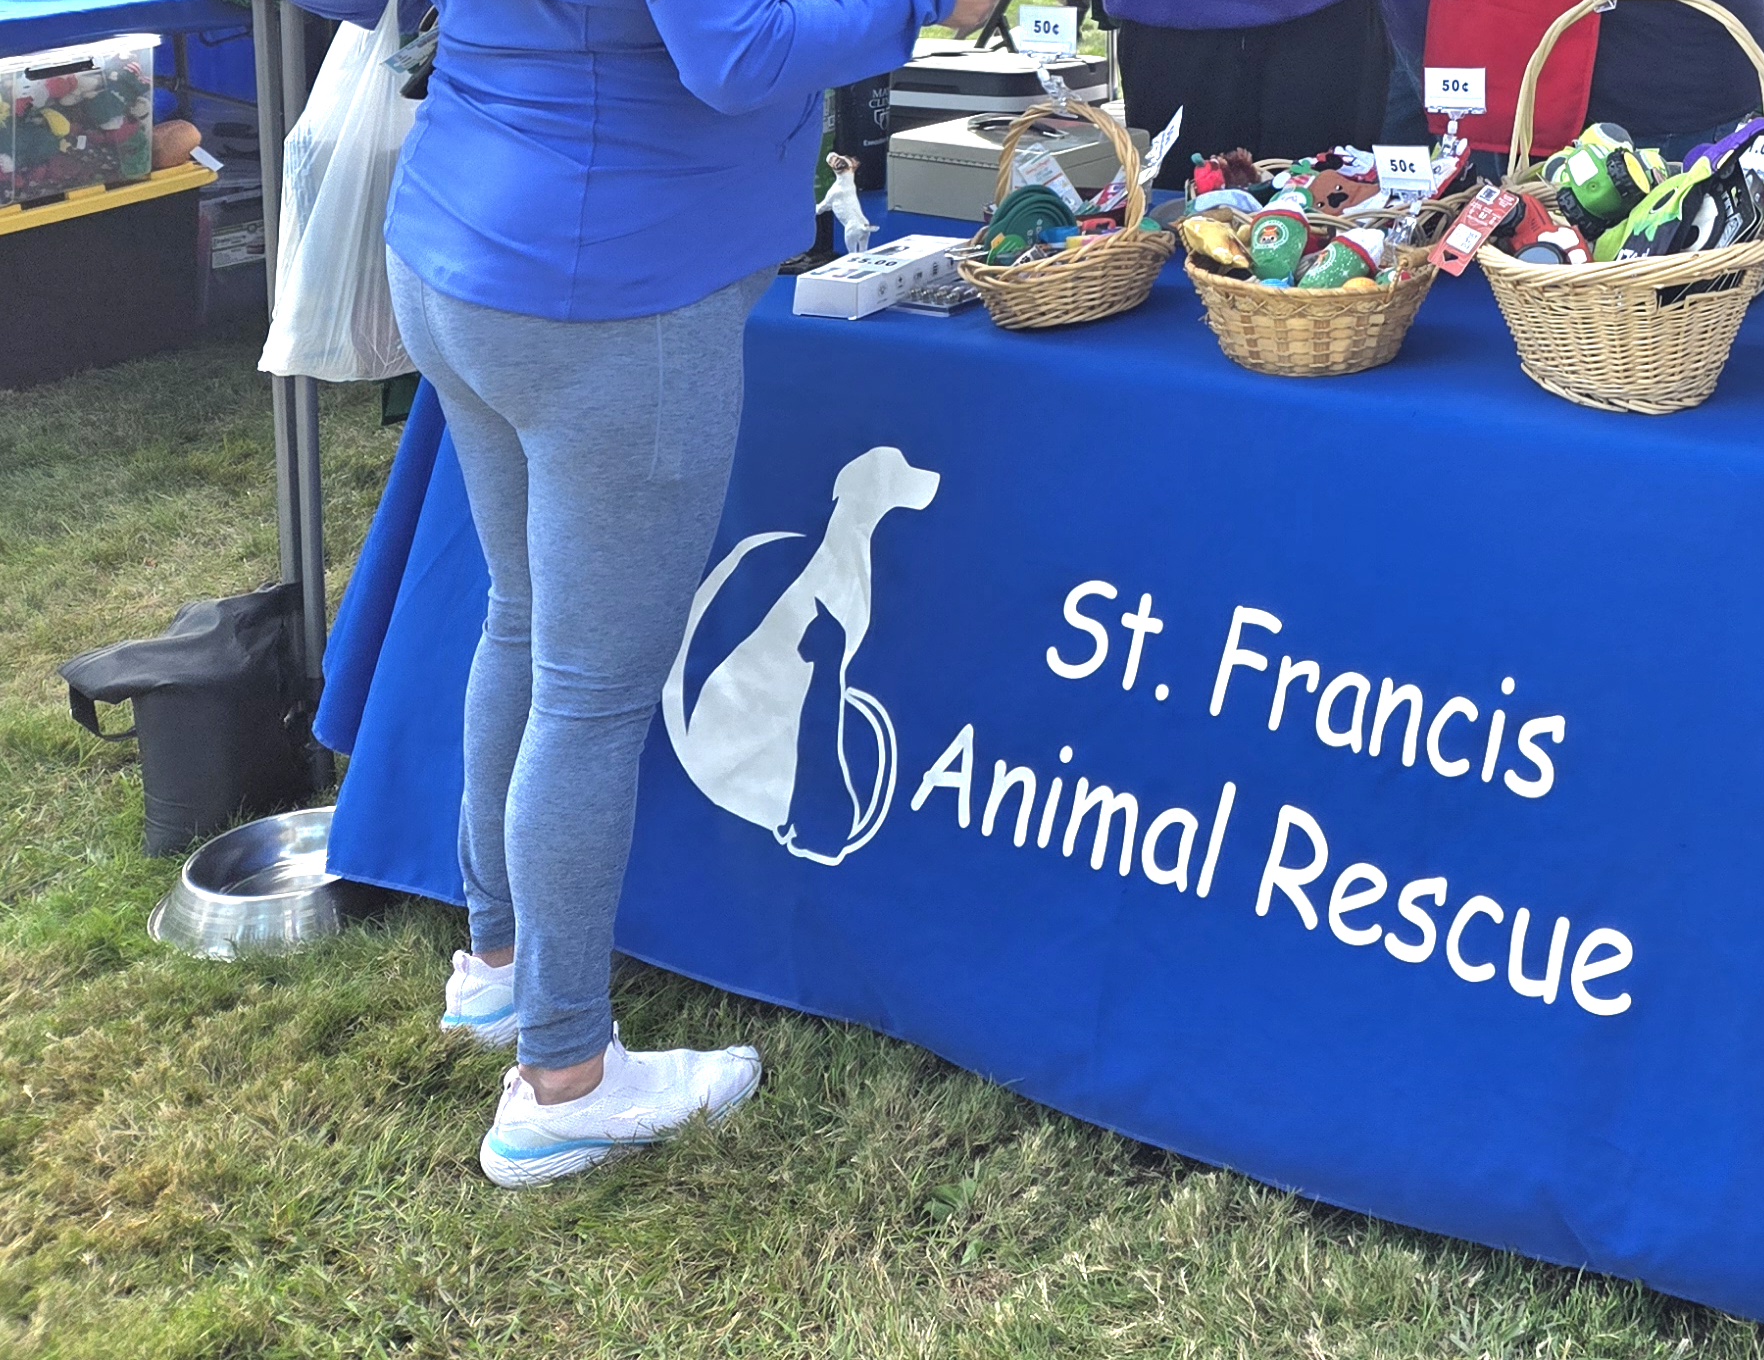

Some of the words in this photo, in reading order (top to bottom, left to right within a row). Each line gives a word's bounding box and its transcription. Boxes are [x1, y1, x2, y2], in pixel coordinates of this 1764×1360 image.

[1033, 19, 1060, 36] 50¢
[1441, 79, 1470, 93] 50¢
[1390, 158, 1416, 174] 50¢
[1045, 579, 1170, 703] St.
[1208, 605, 1566, 799] Francis
[909, 722, 1237, 899] Animal
[1255, 803, 1634, 1017] Rescue
